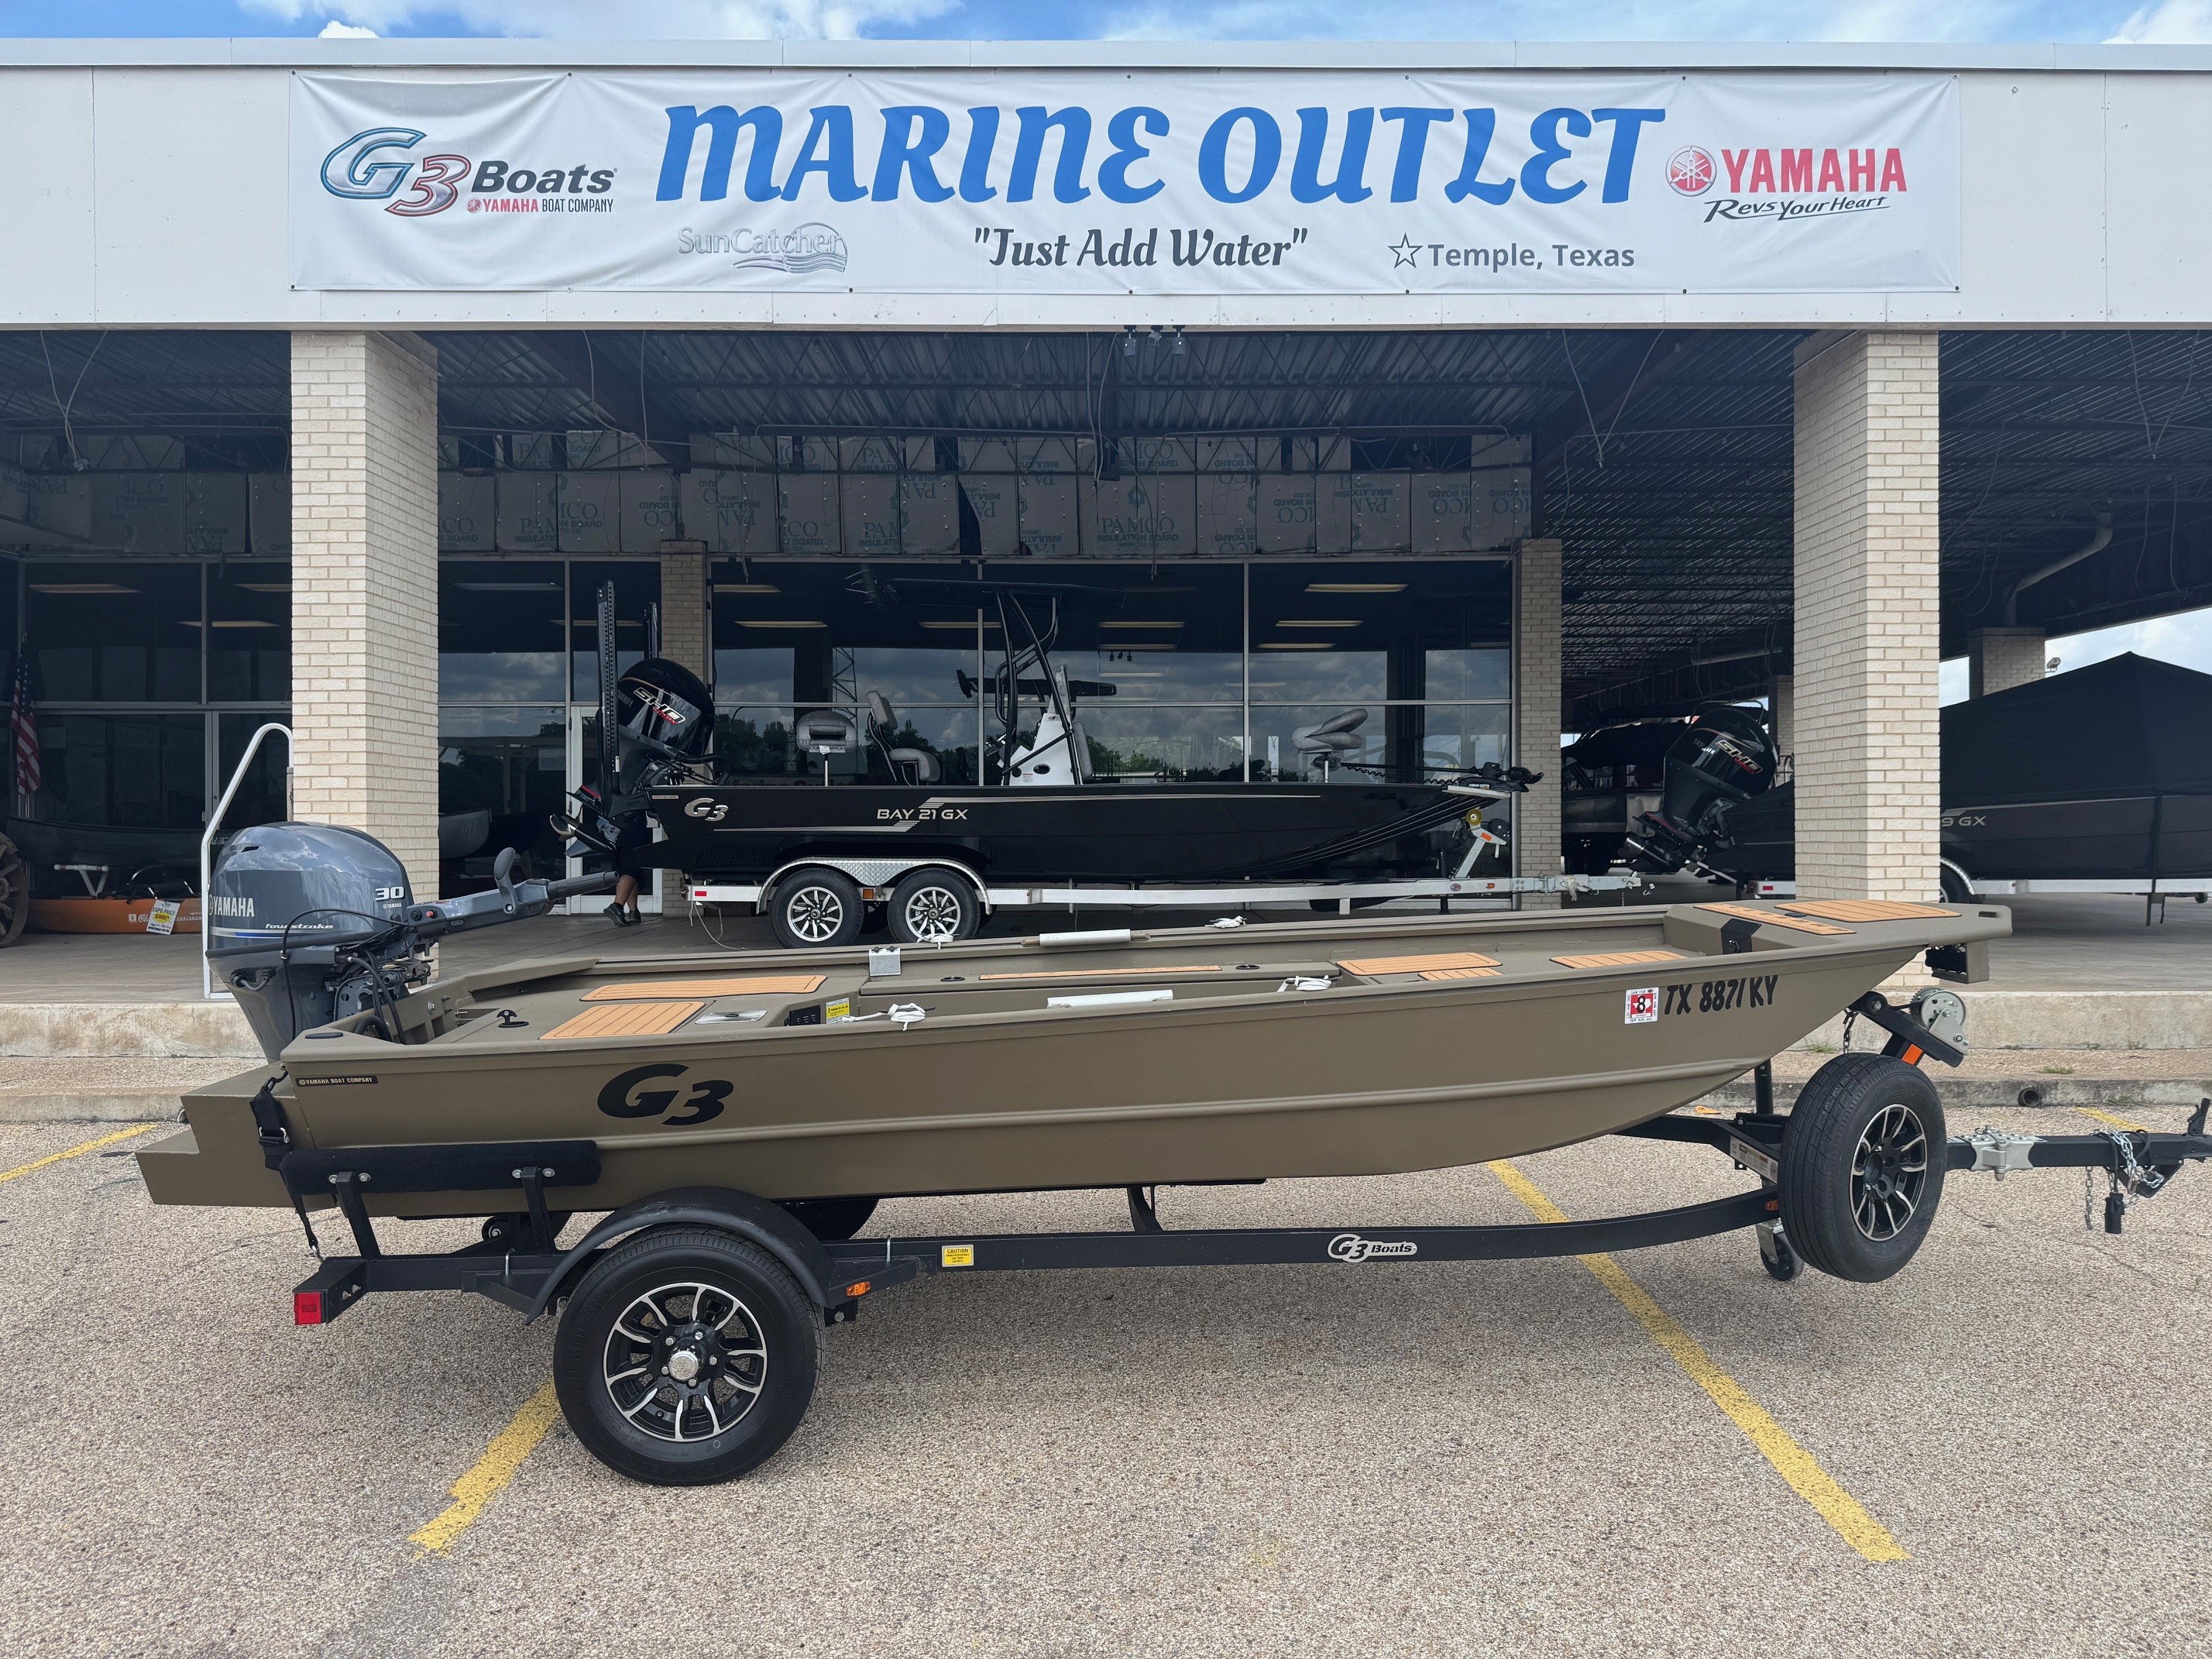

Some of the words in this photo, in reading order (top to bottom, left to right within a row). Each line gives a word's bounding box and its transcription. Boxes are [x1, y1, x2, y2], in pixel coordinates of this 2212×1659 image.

[656, 105, 1170, 204] MARINE
[1198, 105, 1666, 205] OUTLET
[320, 126, 472, 218] G3
[1720, 148, 1908, 194] YAMAHA
[483, 198, 539, 213] YAMAHA
[541, 198, 565, 213] BOAT
[568, 198, 614, 213] COMPANY
[1703, 198, 1778, 223] Revs
[1777, 199, 1830, 222] Your
[1829, 196, 1888, 212] Heart
[677, 226, 844, 256] SunCatcher
[974, 227, 1072, 267] "Just
[1077, 227, 1159, 267] Add
[1170, 227, 1309, 267] Water"
[1427, 242, 1544, 273] Temple,
[1551, 244, 1635, 269] Texas
[1101, 517, 1174, 534] PAMCO
[634, 687, 686, 723] SHO
[684, 797, 730, 822] G3
[877, 809, 915, 819] BAY
[919, 809, 937, 820] 21
[941, 809, 968, 820] GX
[1959, 816, 1987, 826] GX
[375, 886, 404, 901] 30
[213, 897, 256, 918] YAMAHA
[1637, 994, 1646, 1014] 8
[1664, 984, 1693, 1015] TX
[1699, 977, 1747, 1013] 8871
[1750, 974, 1778, 1008] KY
[596, 1063, 734, 1126] G3
[1329, 1235, 1369, 1261] G3
[1371, 1243, 1413, 1253] Boats
